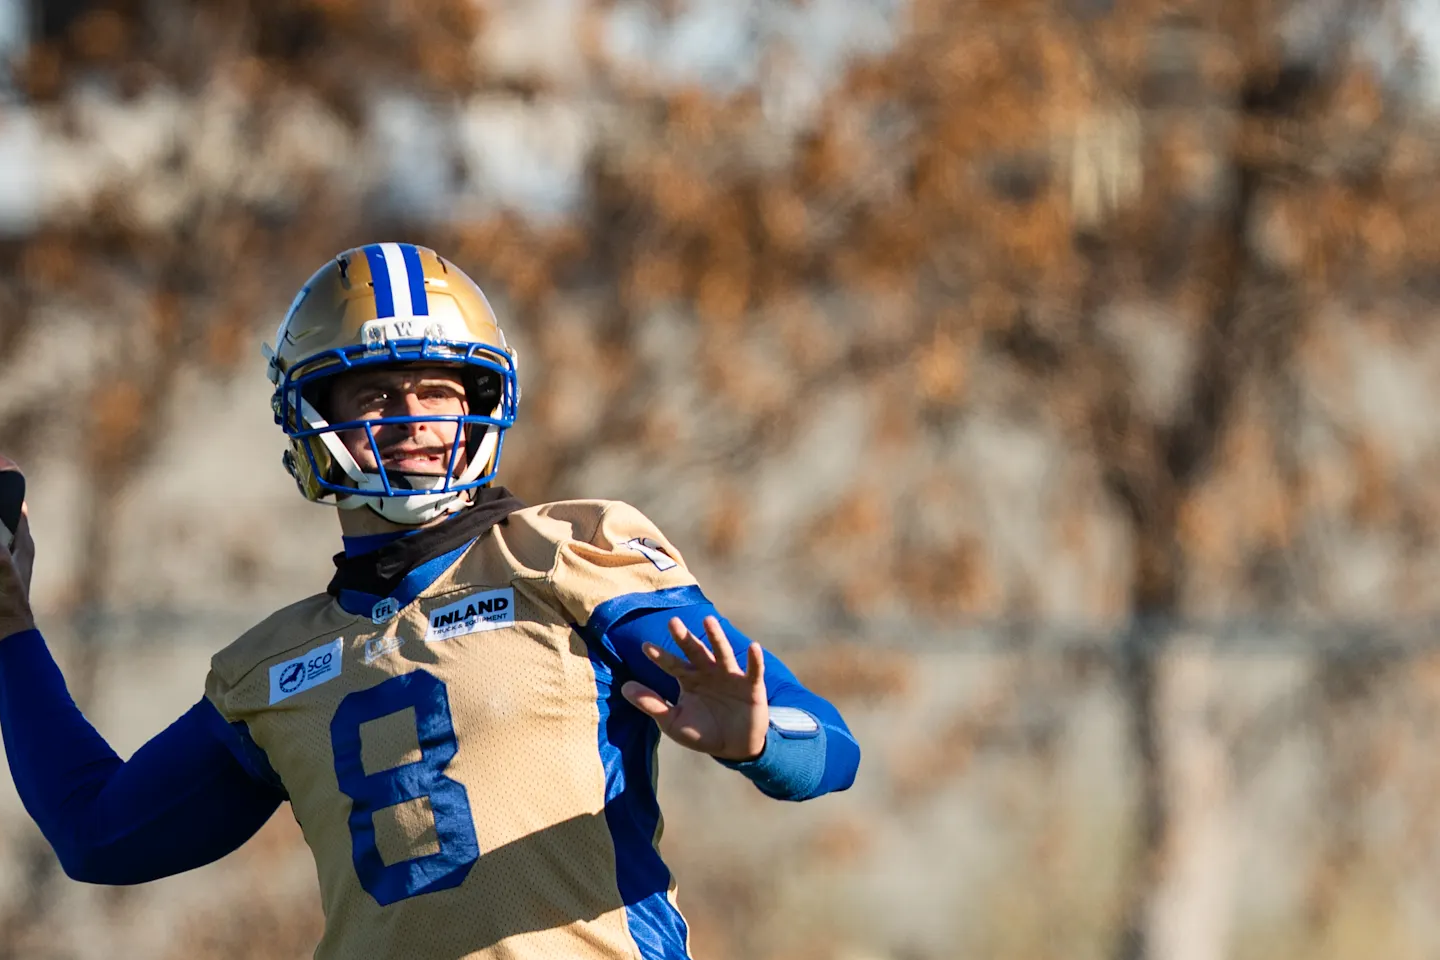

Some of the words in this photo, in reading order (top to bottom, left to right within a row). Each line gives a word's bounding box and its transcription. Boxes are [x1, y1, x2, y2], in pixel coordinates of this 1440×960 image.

[375, 604, 394, 619] CFL
[433, 597, 509, 628] INLAND
[433, 624, 457, 635] TRUCK
[308, 653, 333, 672] SCO
[330, 668, 479, 906] 8
